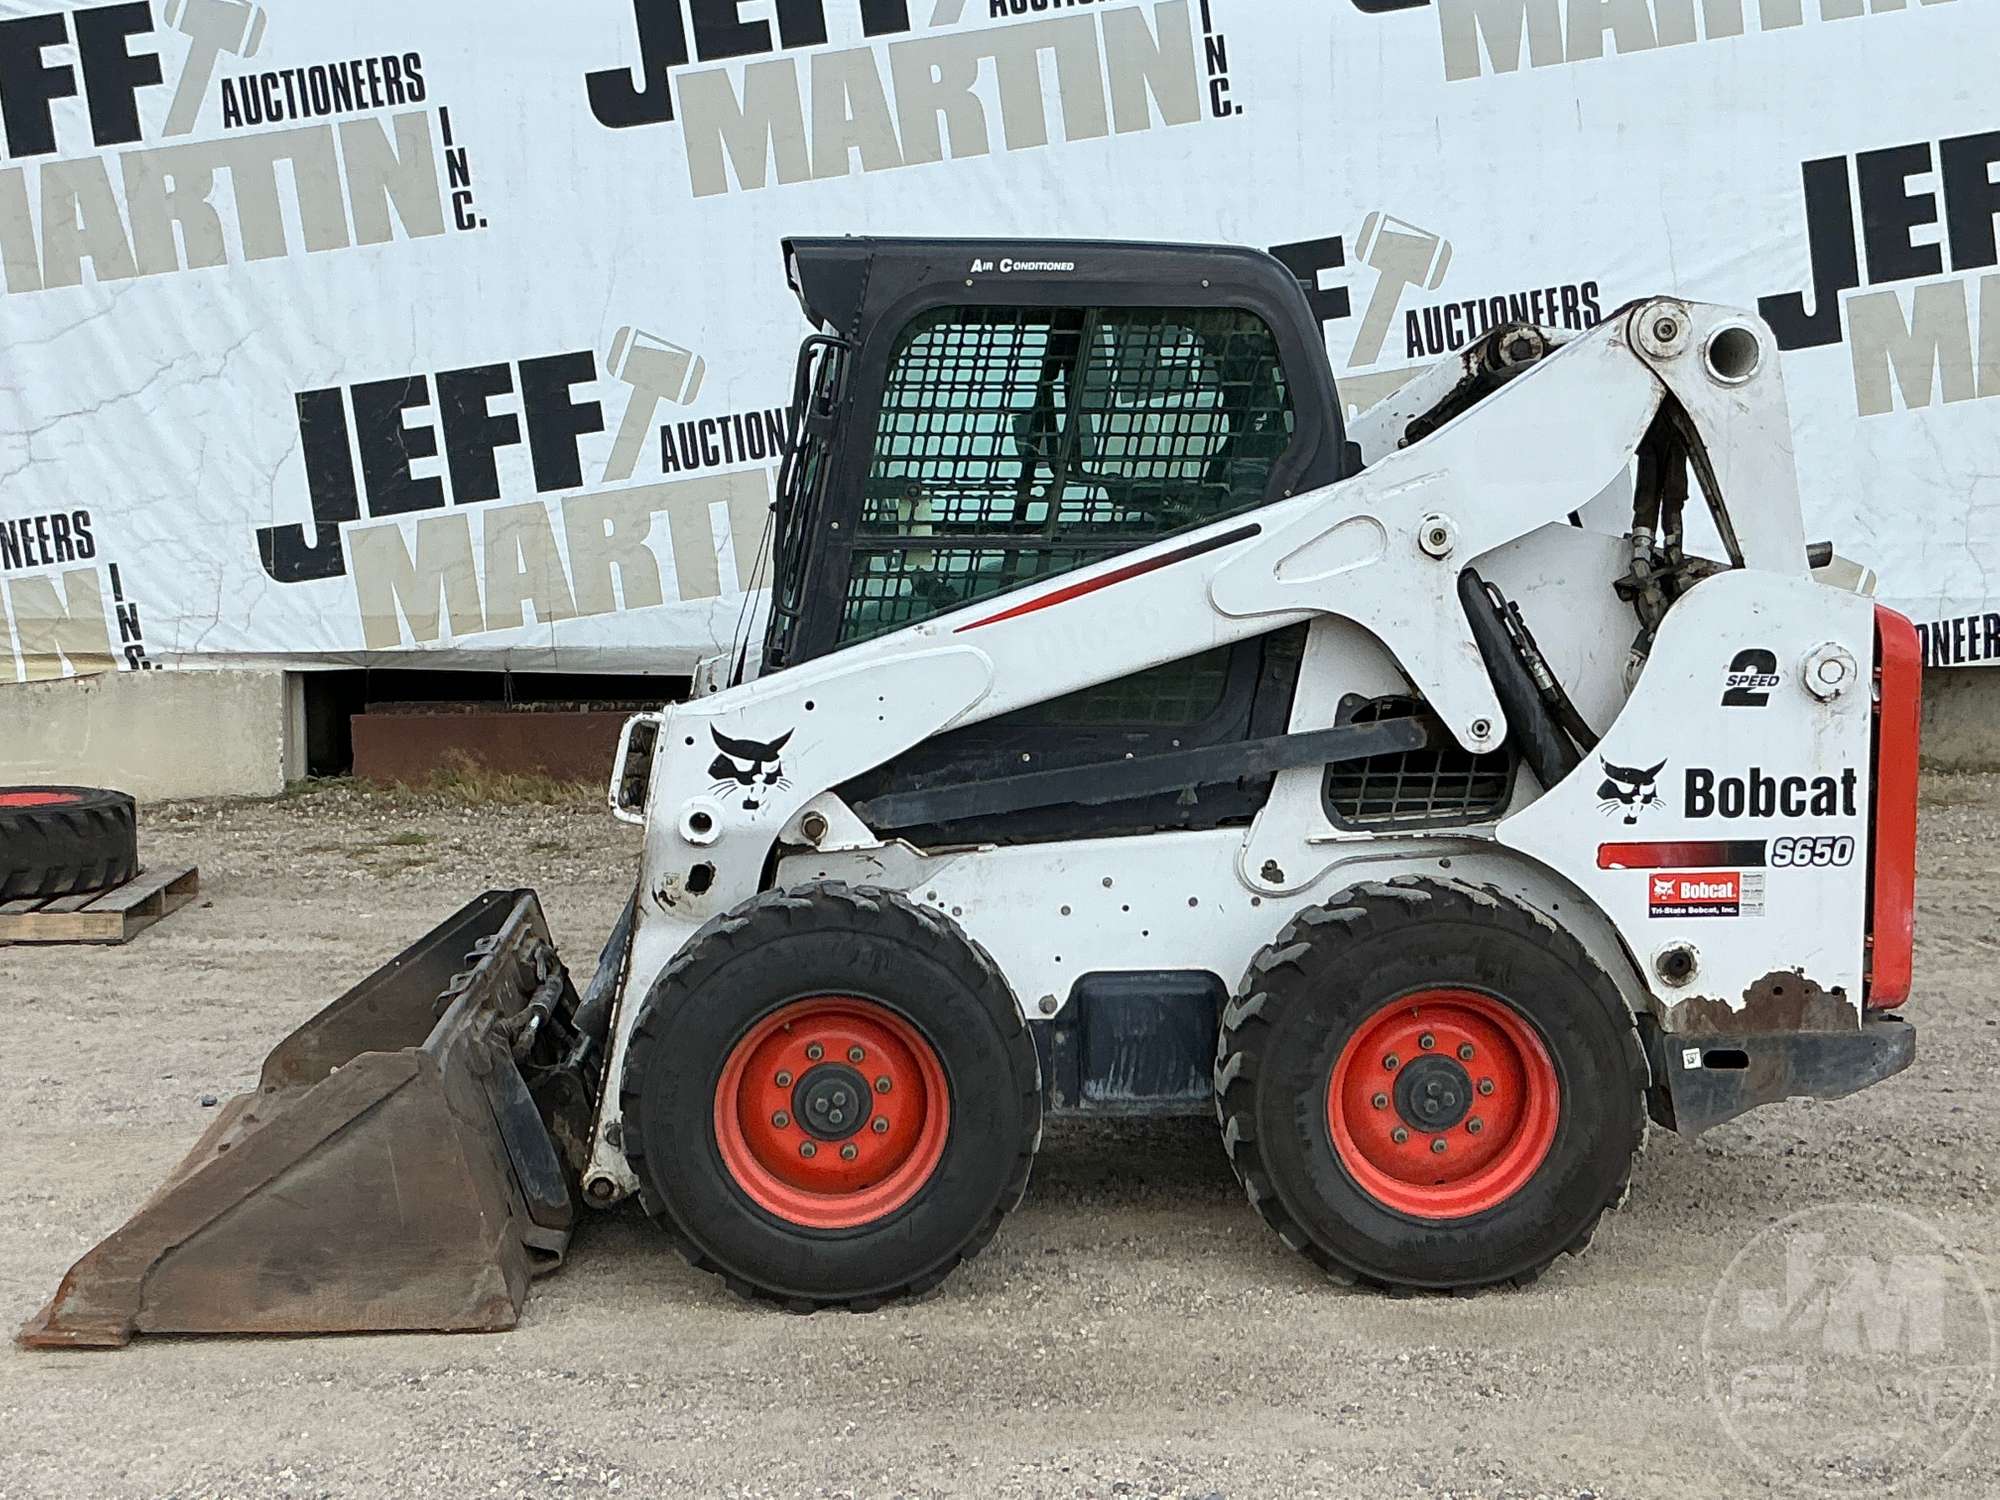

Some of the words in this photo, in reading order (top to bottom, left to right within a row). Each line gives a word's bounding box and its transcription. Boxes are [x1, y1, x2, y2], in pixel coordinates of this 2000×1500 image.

[0, 0, 163, 159] FF
[221, 52, 426, 129] AUCTIONEERS
[676, 1, 1203, 197] MARTIN
[440, 106, 487, 231] INC.
[256, 350, 605, 583] JEFF
[660, 405, 792, 474] AUCTION
[348, 466, 780, 650] MARTI
[1720, 648, 1777, 707] 2
[1725, 674, 1780, 687] SPEED
[1684, 767, 1858, 819] Bobcat
[1771, 836, 1854, 868] S650
[1651, 906, 1687, 915] Tri-State
[1680, 881, 1734, 899] Bobcat
